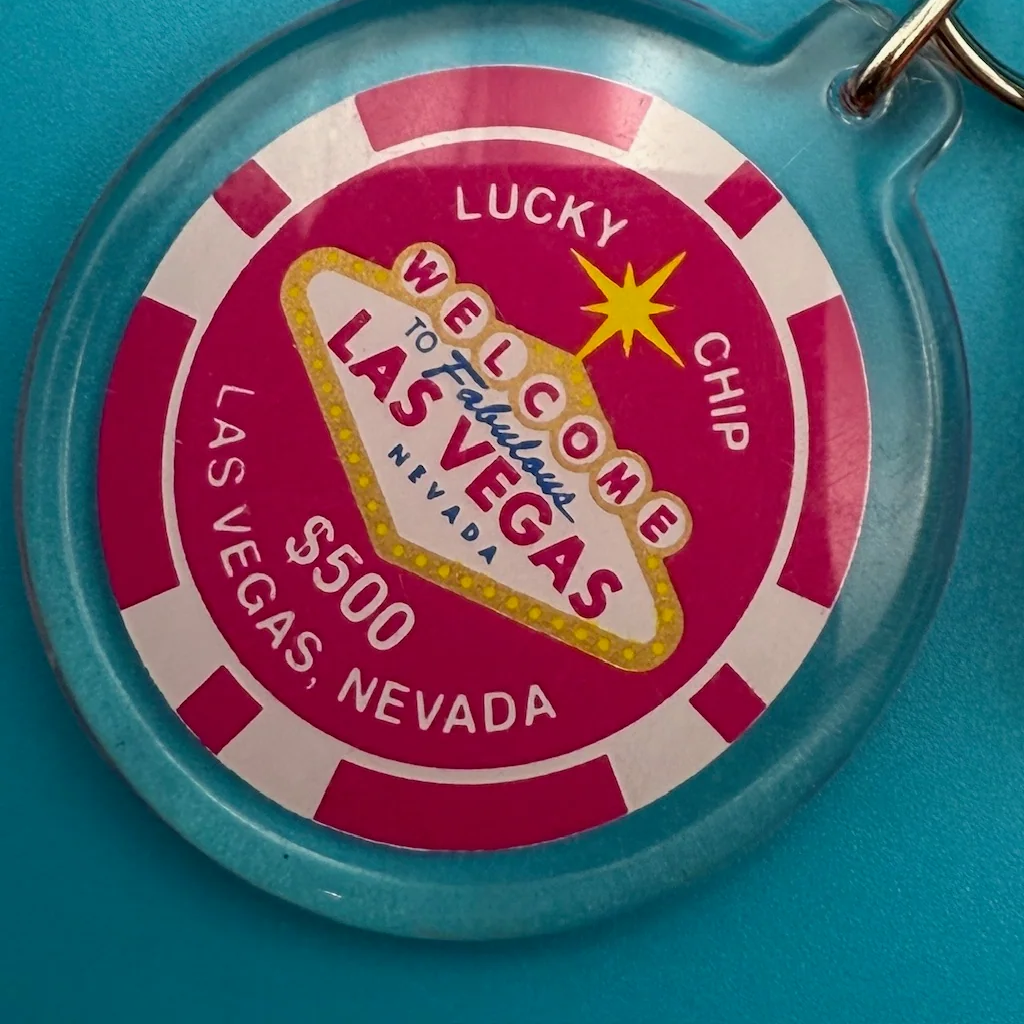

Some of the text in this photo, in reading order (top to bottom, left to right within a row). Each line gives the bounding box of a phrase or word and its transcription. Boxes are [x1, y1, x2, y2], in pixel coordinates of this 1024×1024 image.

[455, 183, 628, 248] LUCKY
[326, 309, 623, 620] LAS VEGAS
[402, 248, 679, 545] WELCOME
[405, 317, 576, 523] TO Fabulous
[693, 332, 750, 451] CHIP
[206, 384, 557, 735] LAS VEGAS, NEVADA
[285, 516, 415, 651] $500
[388, 444, 497, 564] NEVADA
